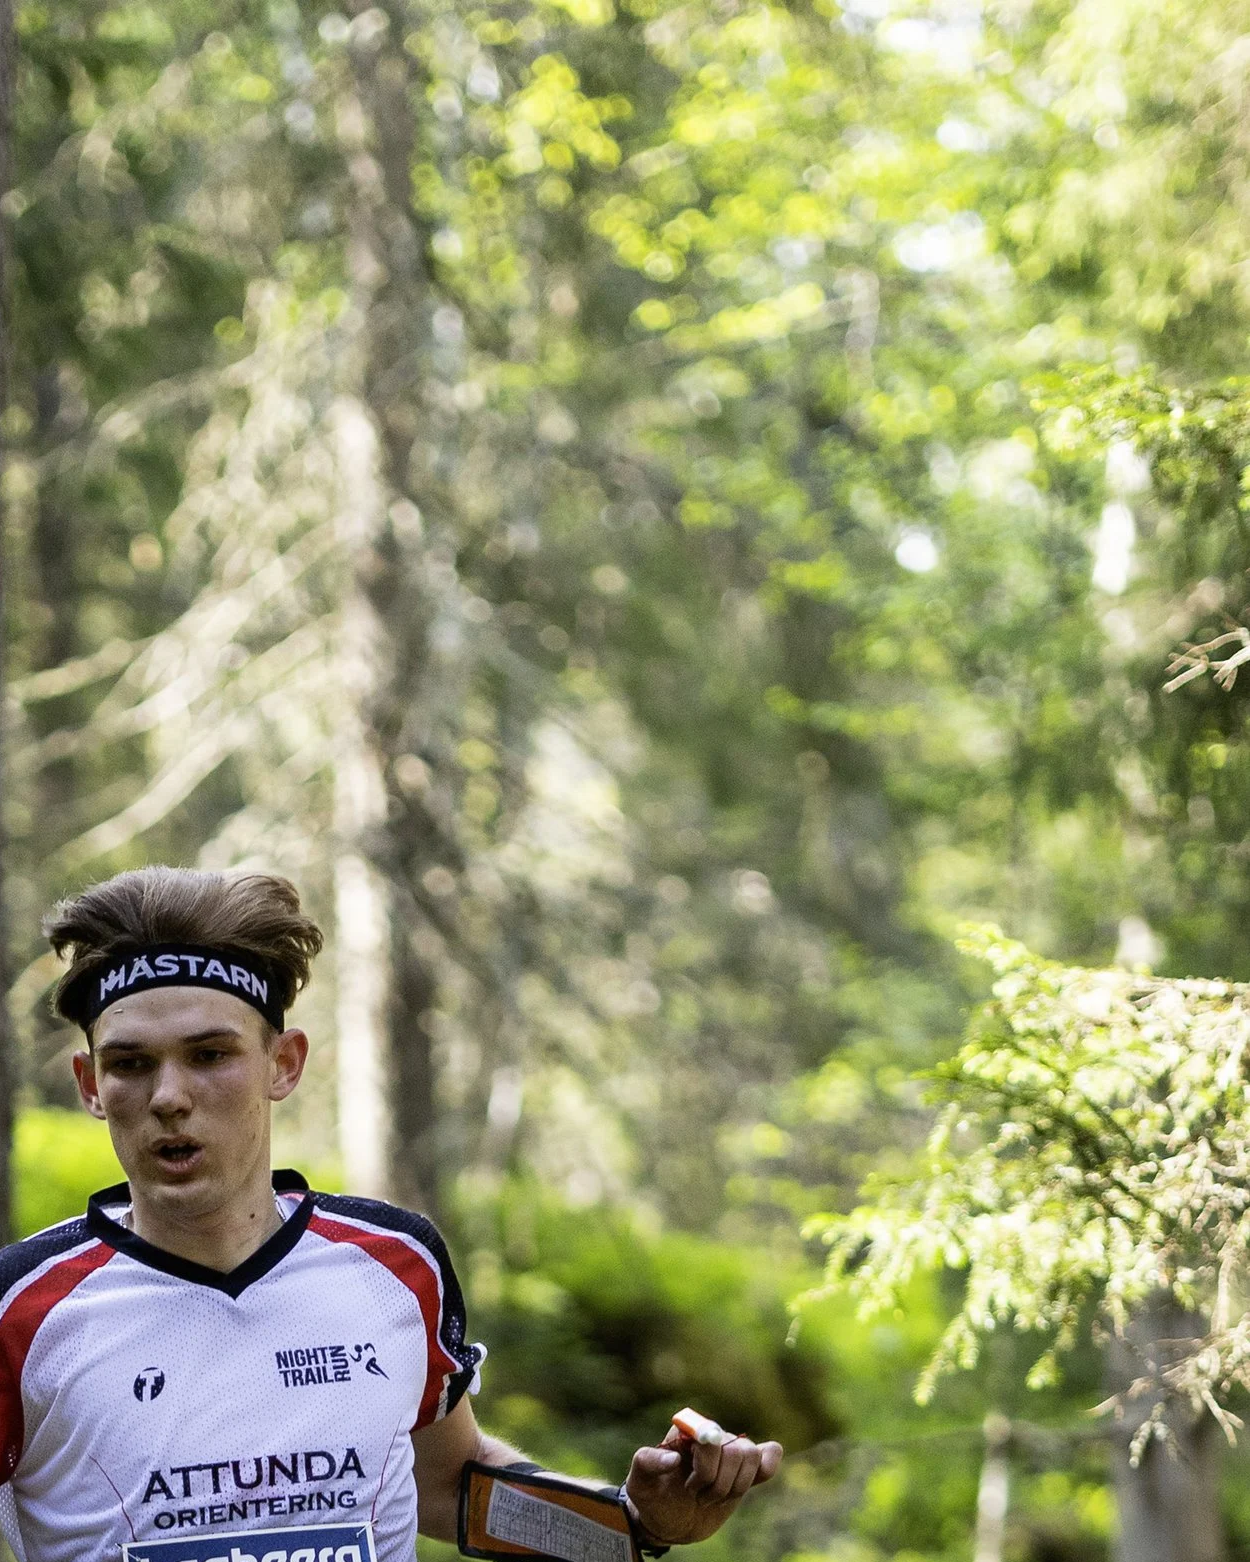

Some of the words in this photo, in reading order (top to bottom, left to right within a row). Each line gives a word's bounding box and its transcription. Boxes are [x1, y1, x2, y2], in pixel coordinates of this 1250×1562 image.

[100, 954, 268, 1004] MÄSTARN
[275, 1347, 328, 1369] NIGHT
[279, 1366, 334, 1388] TRAIL
[329, 1345, 351, 1382] RUN
[141, 1448, 366, 1503] ATTUNDA
[154, 1491, 357, 1530] ORIENTERING
